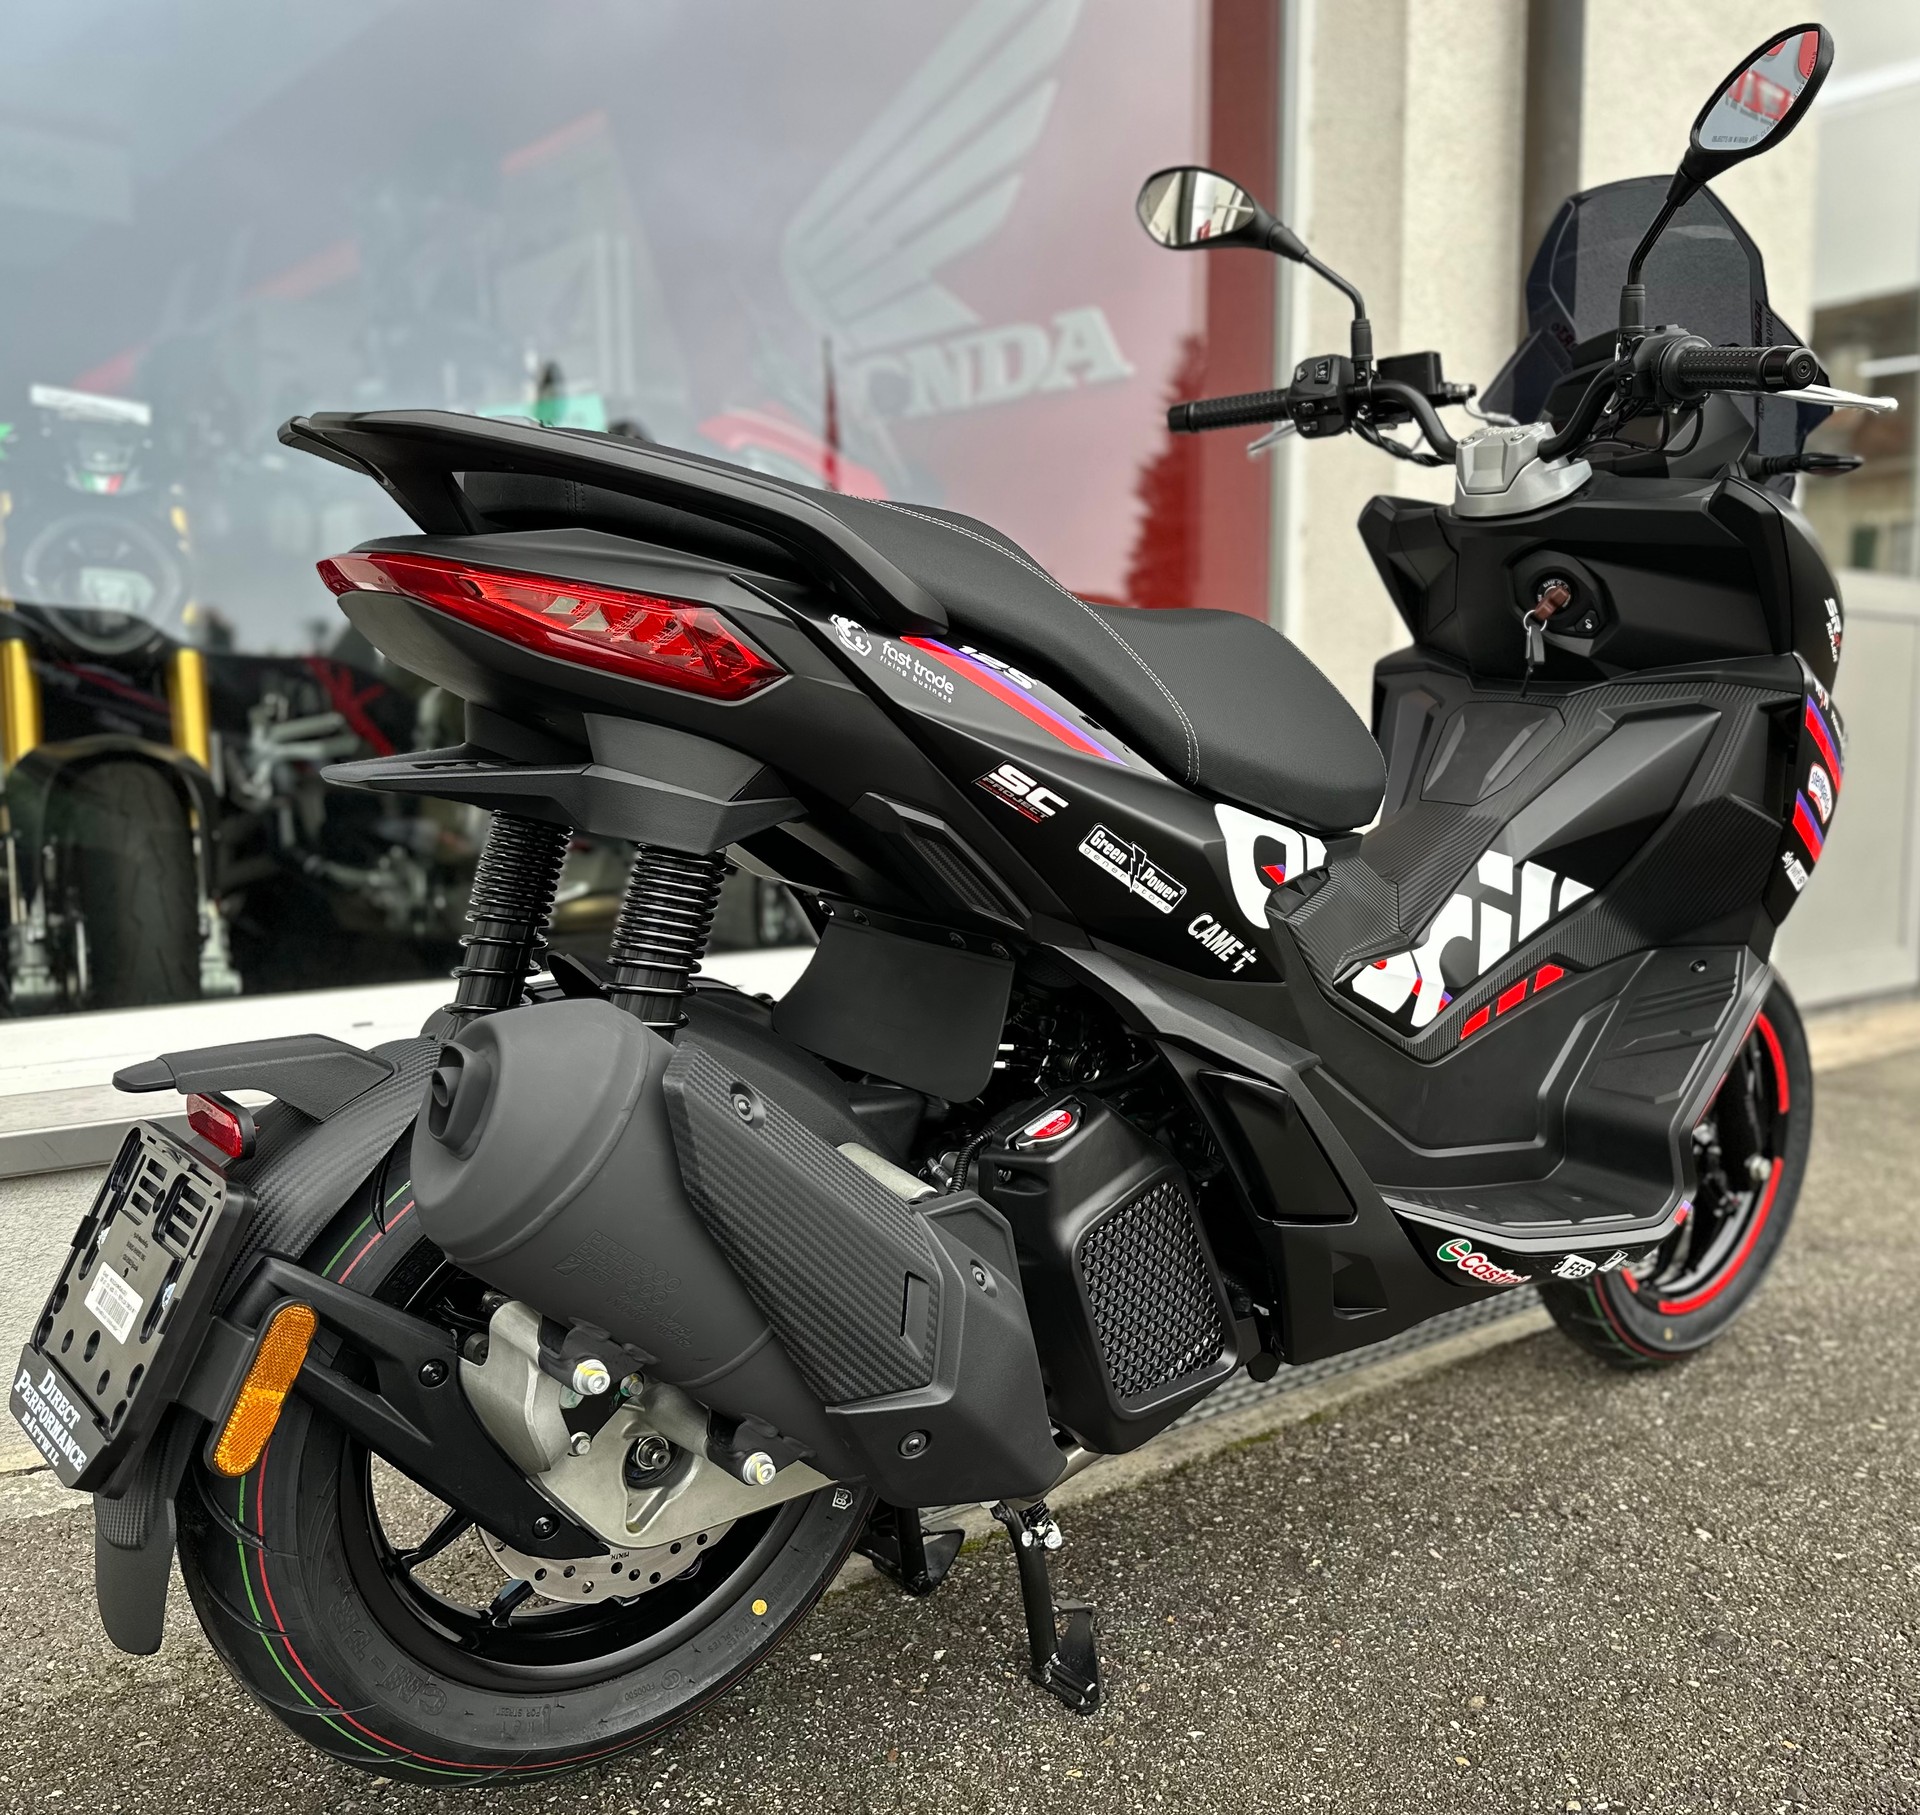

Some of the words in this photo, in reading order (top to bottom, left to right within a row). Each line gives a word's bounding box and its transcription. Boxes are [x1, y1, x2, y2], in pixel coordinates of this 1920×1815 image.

[856, 306, 1135, 420] ONDA
[880, 655, 907, 677] fixing
[912, 674, 952, 703] business
[882, 640, 911, 669] fast
[914, 659, 954, 694] trade
[958, 644, 1038, 690] 125
[982, 777, 1049, 818] PROJECT
[988, 764, 1069, 817] SC
[1083, 847, 1170, 912] generators
[1089, 829, 1128, 865] Green
[1140, 866, 1179, 901] Power
[1187, 913, 1237, 962] CAME
[13, 1368, 88, 1473] PERFORMANCE
[38, 1368, 81, 1430] DIRECT
